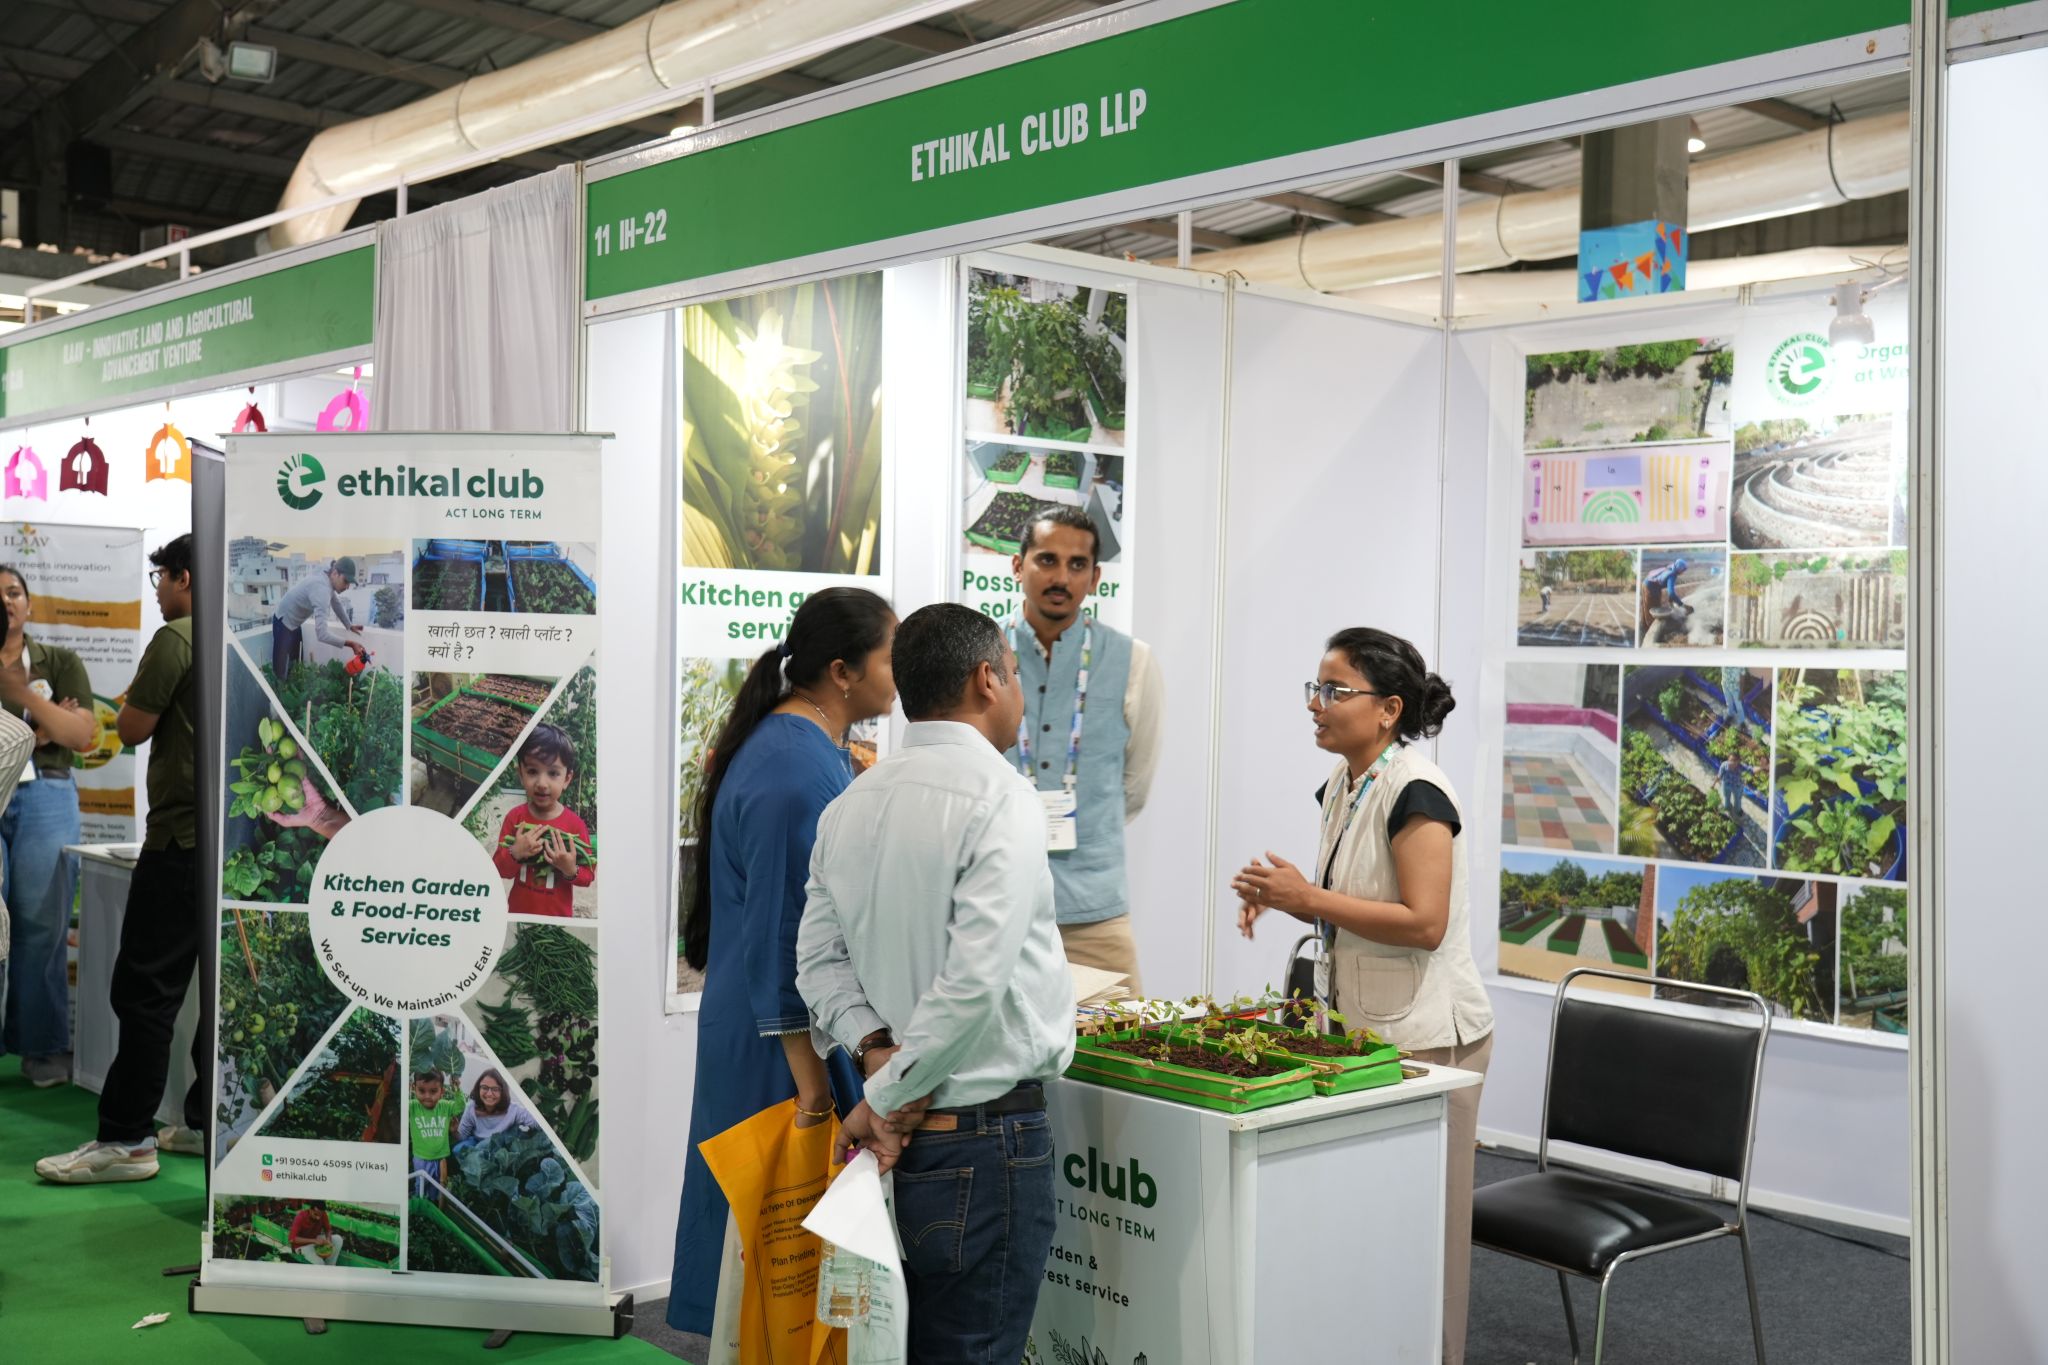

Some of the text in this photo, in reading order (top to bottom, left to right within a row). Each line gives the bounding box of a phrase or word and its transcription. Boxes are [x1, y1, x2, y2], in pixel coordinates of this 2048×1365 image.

[911, 88, 1147, 183] ETHIKAL CLUB LLP
[594, 208, 668, 257] 11 IH-22
[92, 328, 140, 359] INNOVATIVE
[140, 321, 164, 346] LAND
[165, 316, 184, 340] AND
[186, 296, 254, 335] AGRICULTURAL
[101, 338, 203, 383] ADVANCEMENT VENTURE
[1768, 335, 1801, 367] ETHIKAL
[1857, 345, 1909, 362] Orga
[337, 464, 544, 499] ethikal club
[445, 508, 542, 520] ACT LONG TERM
[25, 573, 79, 583] to success
[54, 563, 111, 572] innovation
[681, 580, 783, 608] Kitchen
[428, 621, 460, 638] खाली
[464, 625, 487, 639] छत
[499, 624, 530, 641] खाली
[323, 873, 491, 897] Kitchen Garden
[330, 900, 482, 923] & Food-Forest
[360, 927, 451, 947] Services
[320, 938, 493, 1011] We Set-up, We Maintain, You Eat!
[276, 1172, 328, 1182] ethikal.club
[289, 1159, 320, 1168] 90540
[322, 1160, 352, 1169] 45095
[355, 1161, 389, 1172] (Vikas)
[1063, 1146, 1158, 1208] club
[1070, 1206, 1110, 1228] LONG
[1116, 1217, 1156, 1242] TERM
[771, 1257, 789, 1268] Plan
[1088, 1255, 1098, 1270] &
[1075, 1278, 1129, 1307] service
